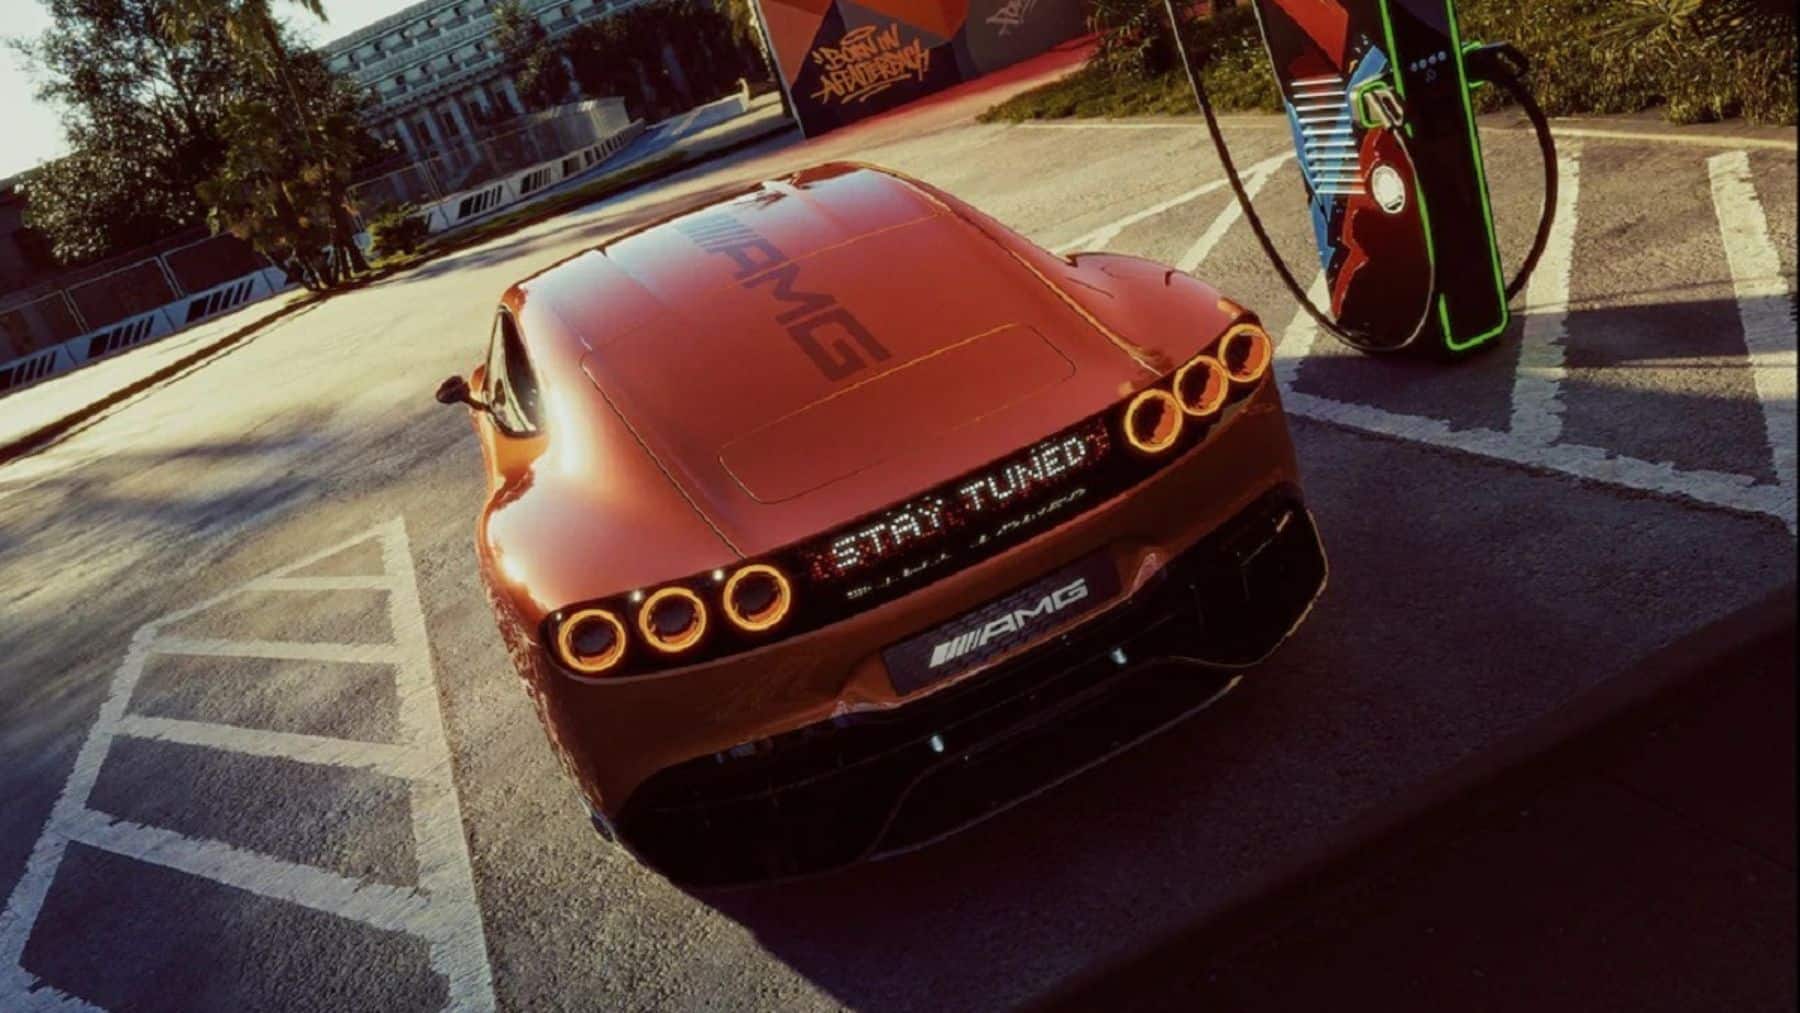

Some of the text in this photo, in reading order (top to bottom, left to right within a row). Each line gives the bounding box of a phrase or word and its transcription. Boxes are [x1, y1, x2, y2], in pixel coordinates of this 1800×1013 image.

[704, 237, 892, 381] AMG
[832, 498, 943, 569] STAY
[959, 436, 1087, 511] TUNED
[976, 577, 1089, 648] AMG
